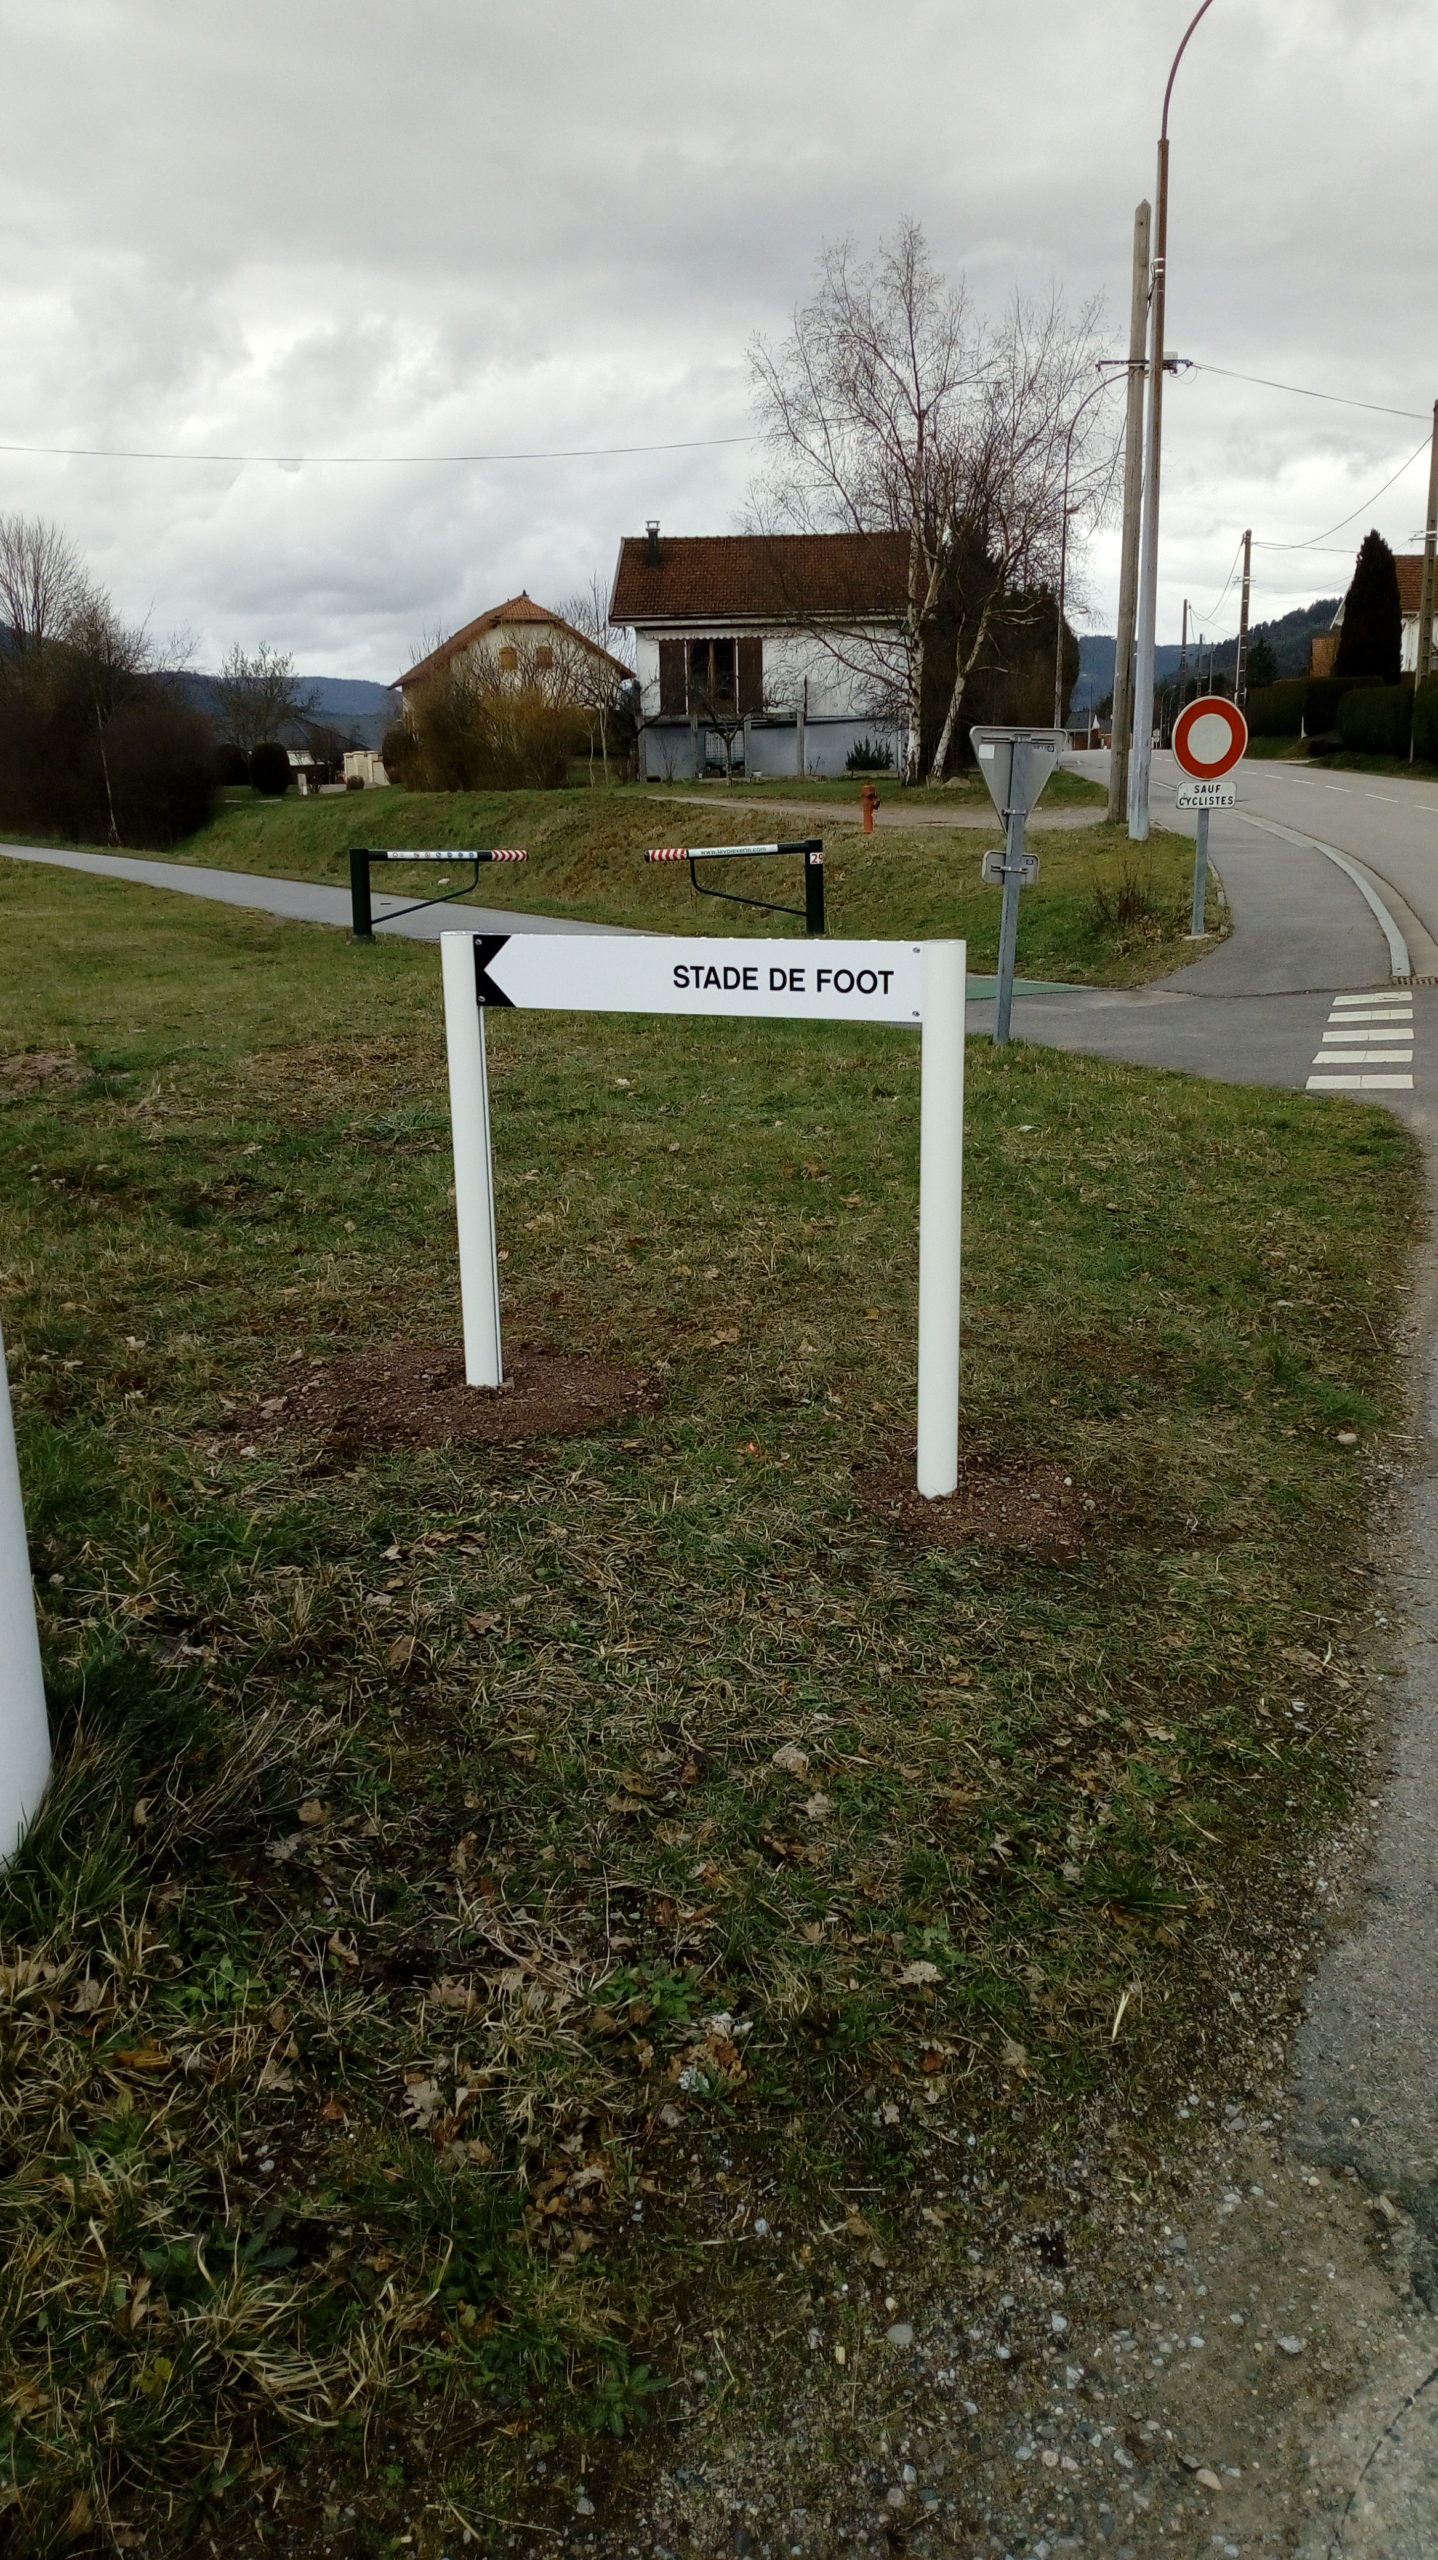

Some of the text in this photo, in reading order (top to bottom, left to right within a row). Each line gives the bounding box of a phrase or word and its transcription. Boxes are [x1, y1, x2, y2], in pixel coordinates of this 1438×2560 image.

[1194, 784, 1221, 794] SAUF
[1179, 796, 1234, 806] CYCLISTES
[673, 965, 894, 995] STADE DE FOOT
